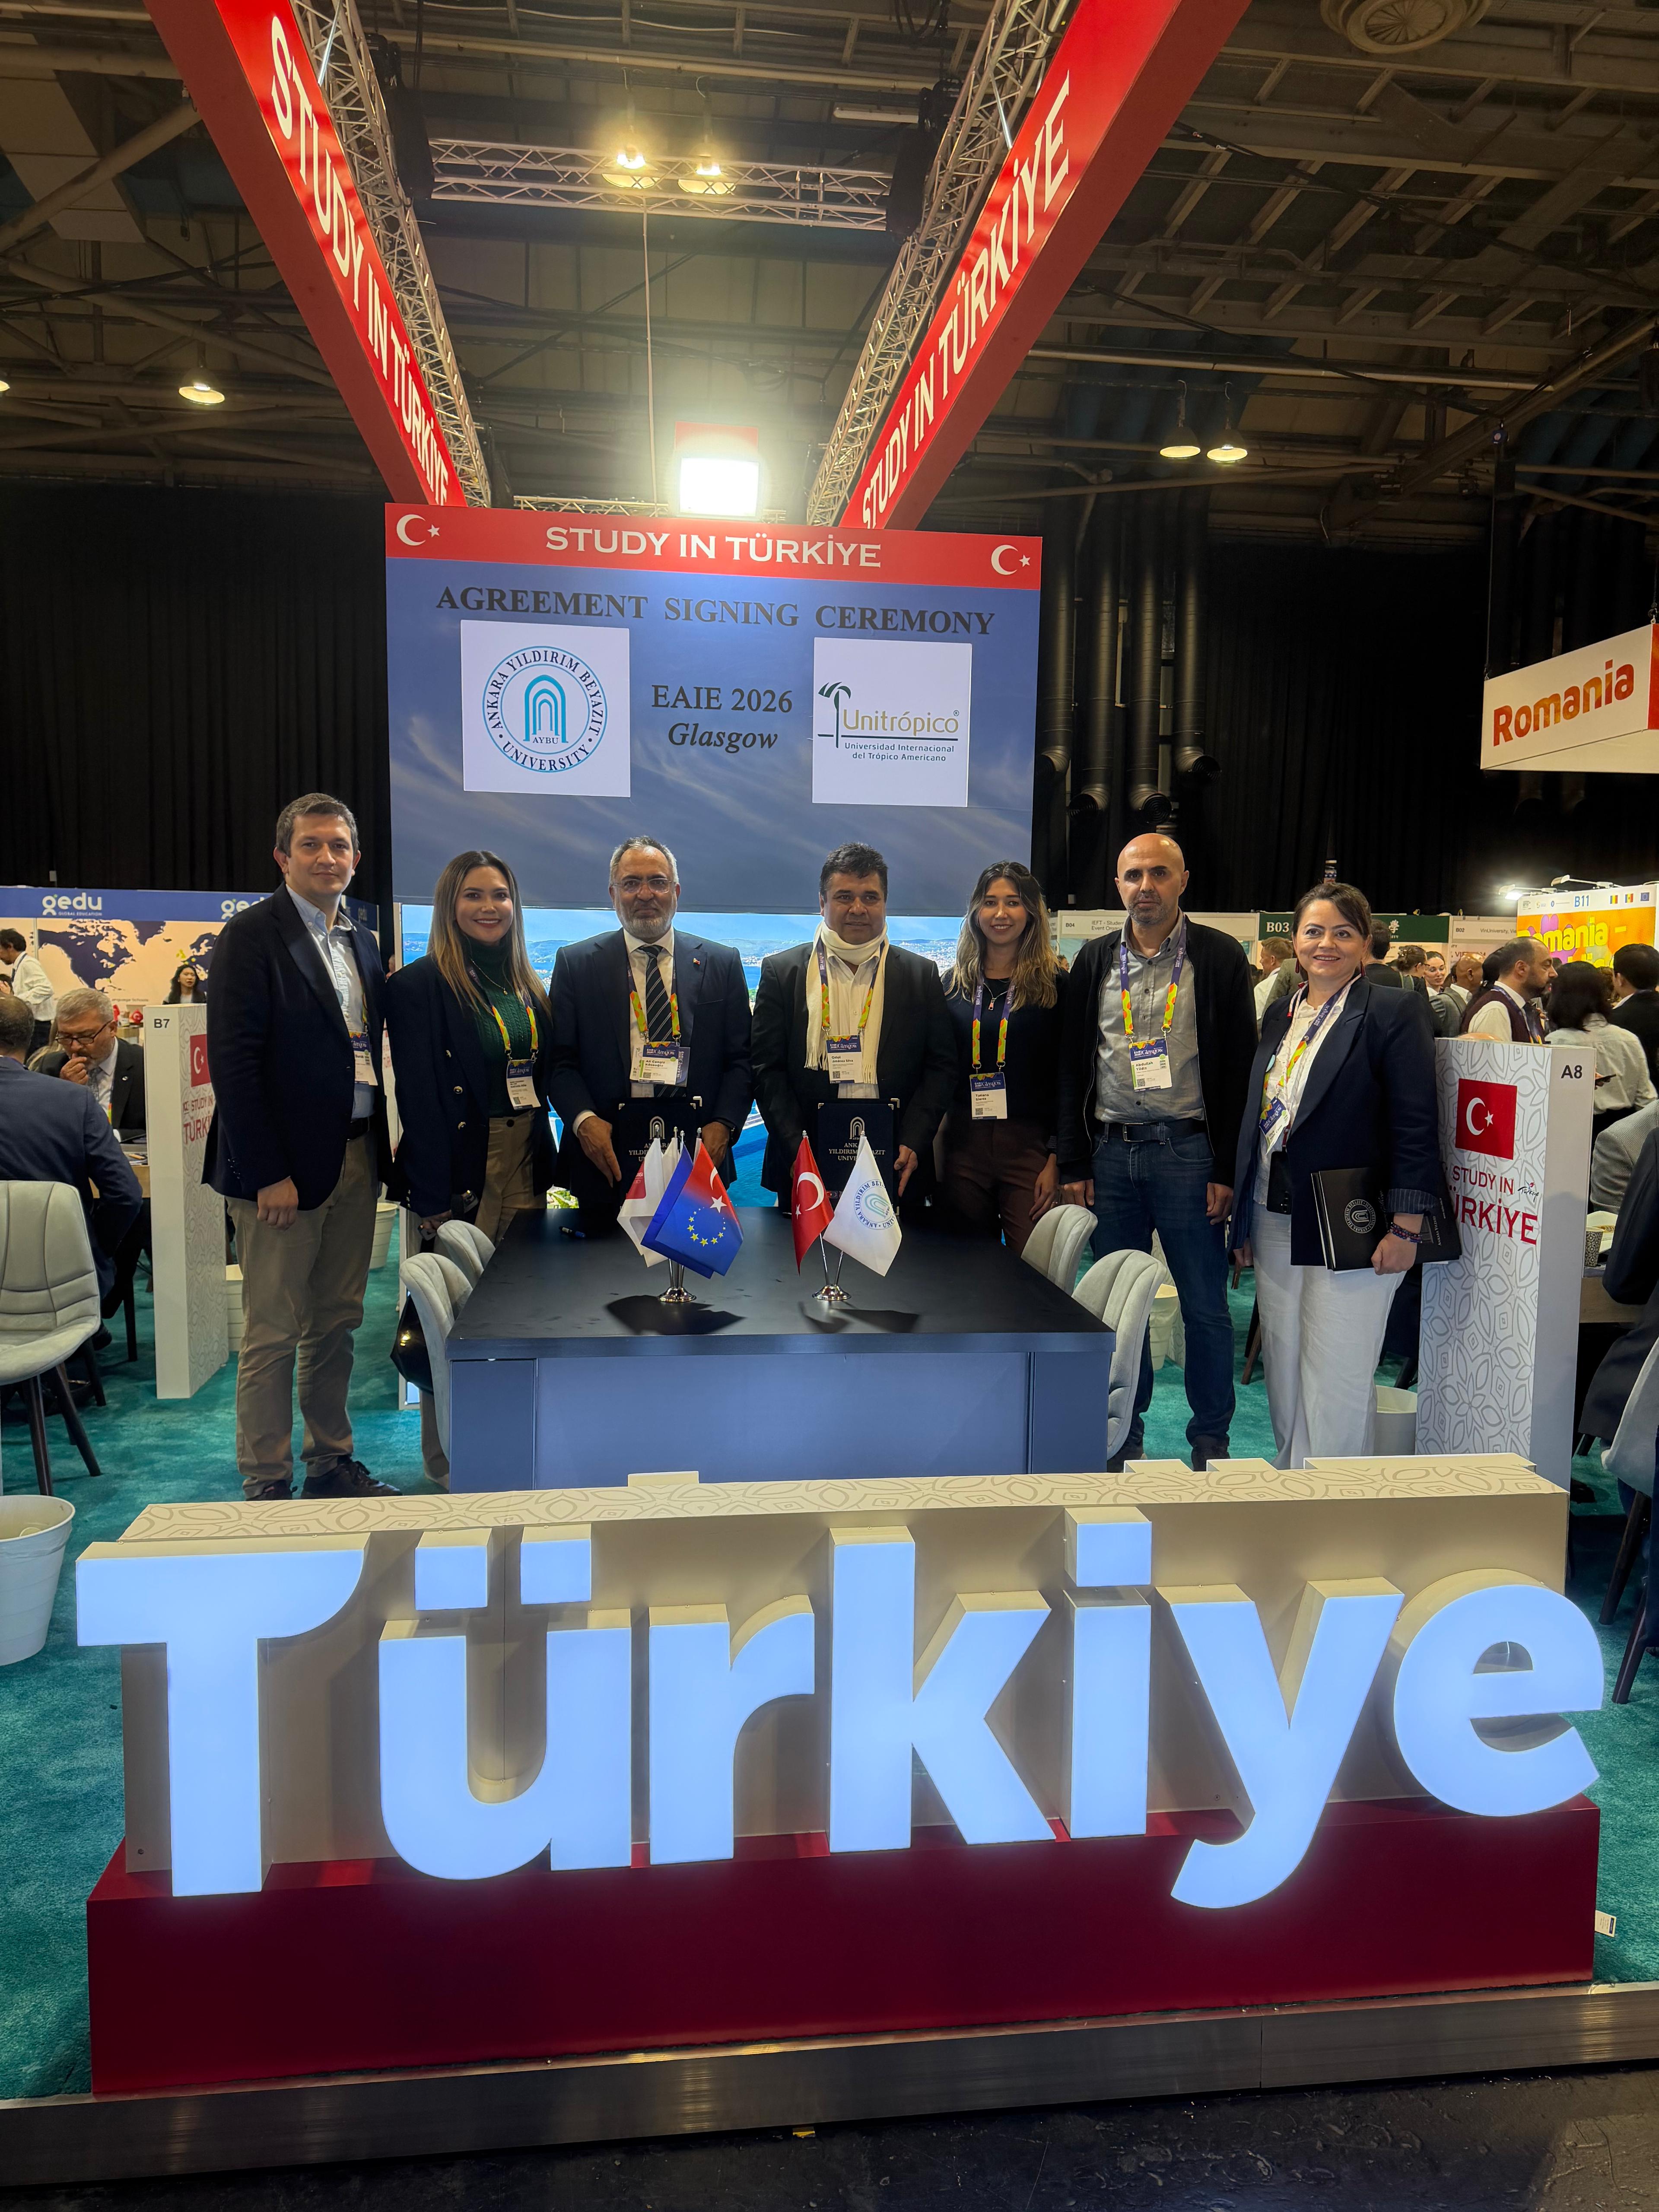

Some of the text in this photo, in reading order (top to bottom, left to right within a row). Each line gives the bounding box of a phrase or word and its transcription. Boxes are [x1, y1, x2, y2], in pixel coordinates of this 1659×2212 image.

[271, 16, 364, 311] STUDY
[368, 263, 388, 379] IN
[863, 69, 1070, 529] STUDY IN TÜRKİYE
[546, 526, 882, 568] STUDY IN TÜRKİYE
[435, 585, 995, 635] AGREEMENT SIGNING CEREMONY
[486, 650, 604, 771] ANKARA YILDIRIM BEYAZIT UNIVERSITY
[652, 684, 793, 713] EAIE 2026
[1493, 658, 1634, 747] Romania
[668, 722, 778, 753] Glasgow
[845, 742, 954, 752] Universidad Internacional
[868, 752, 899, 761] Trópico
[901, 753, 947, 762] Americano
[42, 892, 102, 915] gedu
[221, 896, 265, 919] ge
[1574, 895, 1589, 907] B11
[1266, 922, 1289, 932] B03
[153, 1018, 170, 1028] B7
[1560, 1065, 1583, 1079] A8
[1452, 1165, 1514, 1195] STUDY IN
[855, 1183, 870, 1210] YILDIRIM
[857, 1211, 877, 1228] ANKARA
[76, 1516, 1606, 1910] Türkiye
